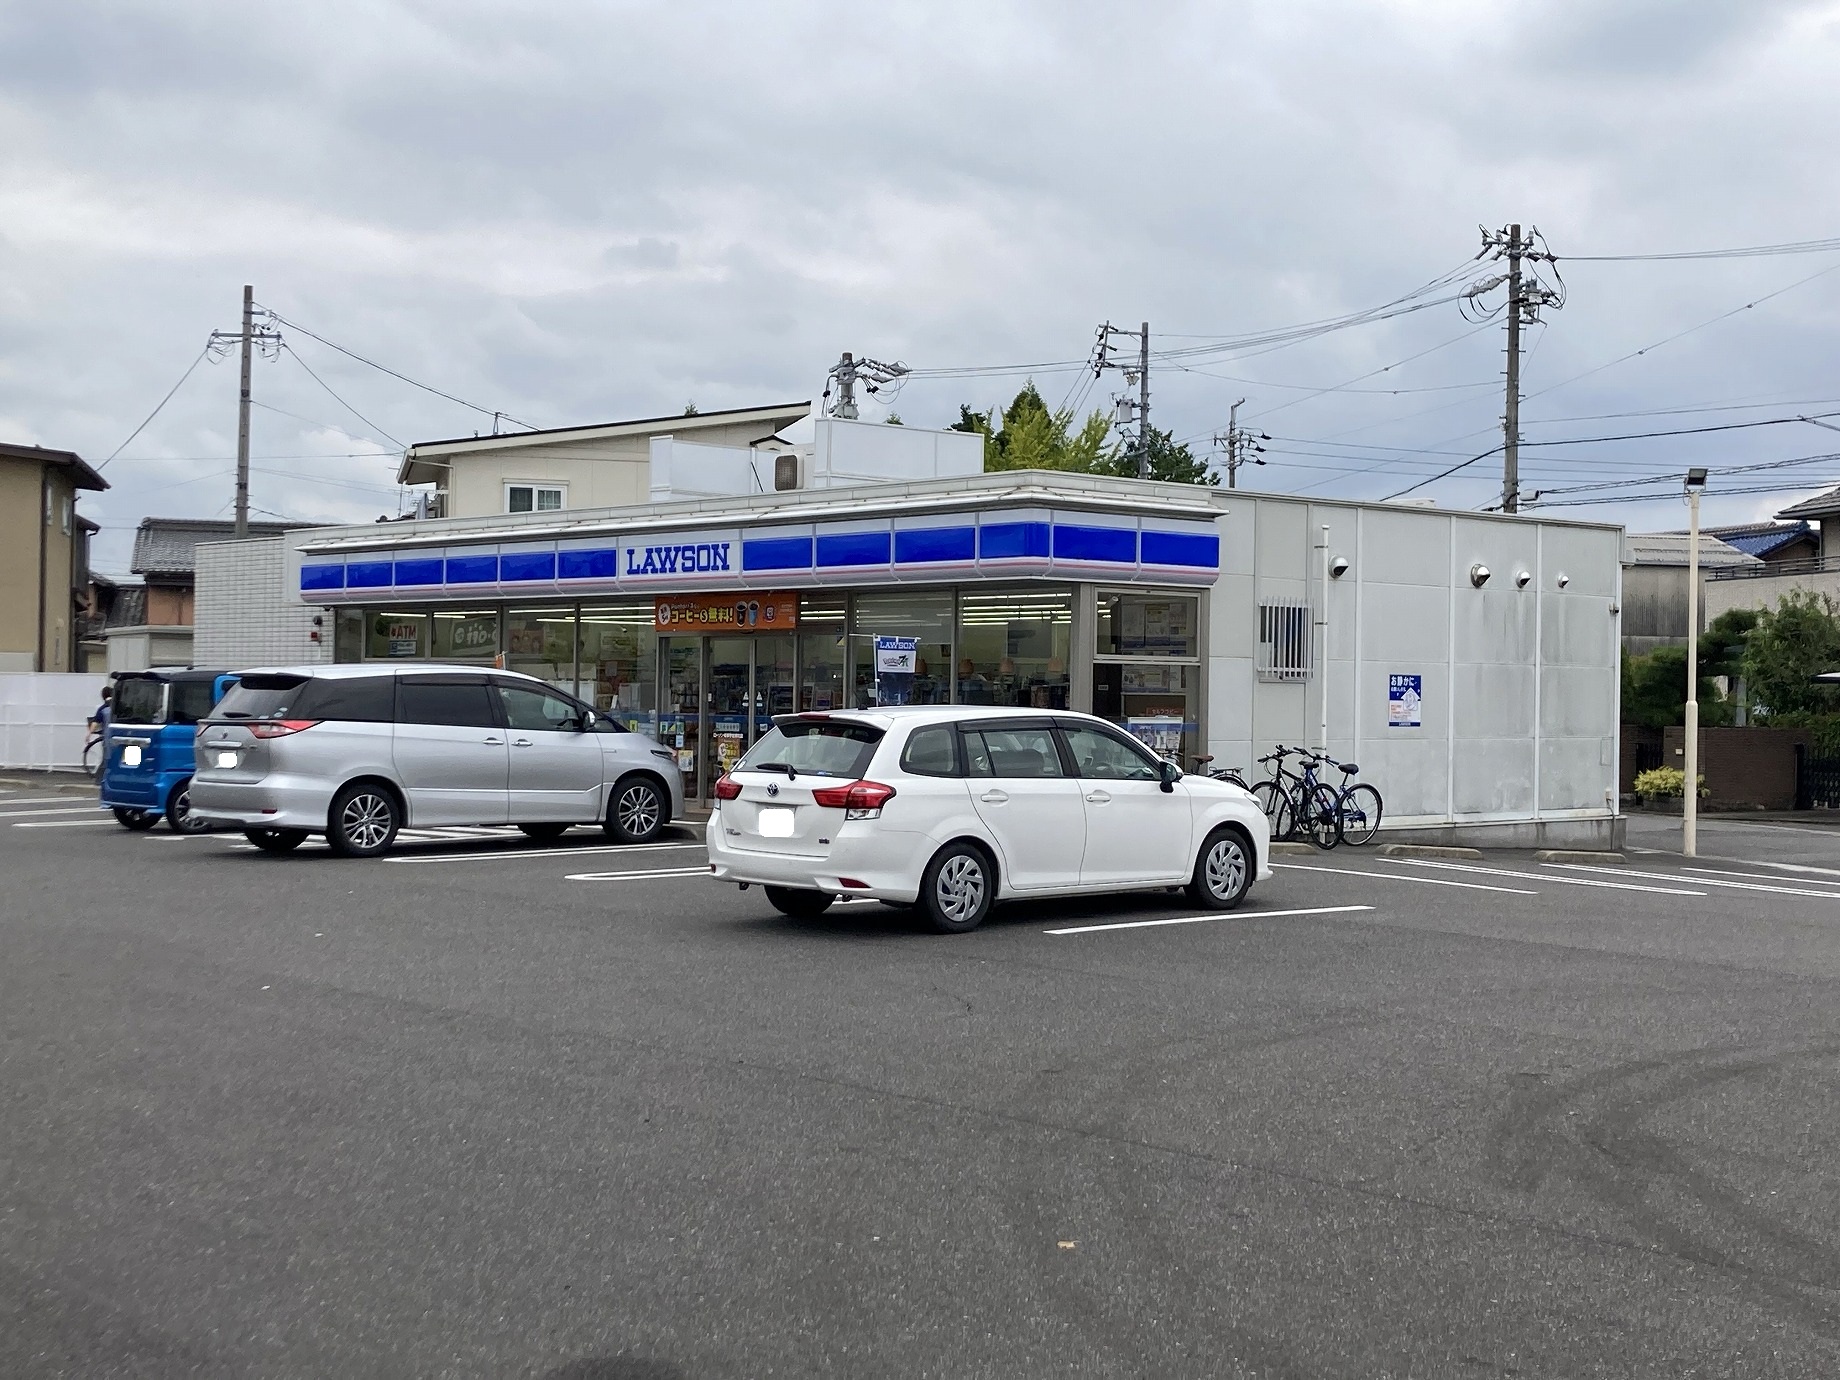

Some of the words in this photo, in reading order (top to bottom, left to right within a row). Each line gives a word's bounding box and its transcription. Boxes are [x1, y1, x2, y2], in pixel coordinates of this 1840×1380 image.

[627, 543, 730, 575] LAWSON
[397, 625, 416, 639] ATM
[880, 641, 915, 650] LAWSON
